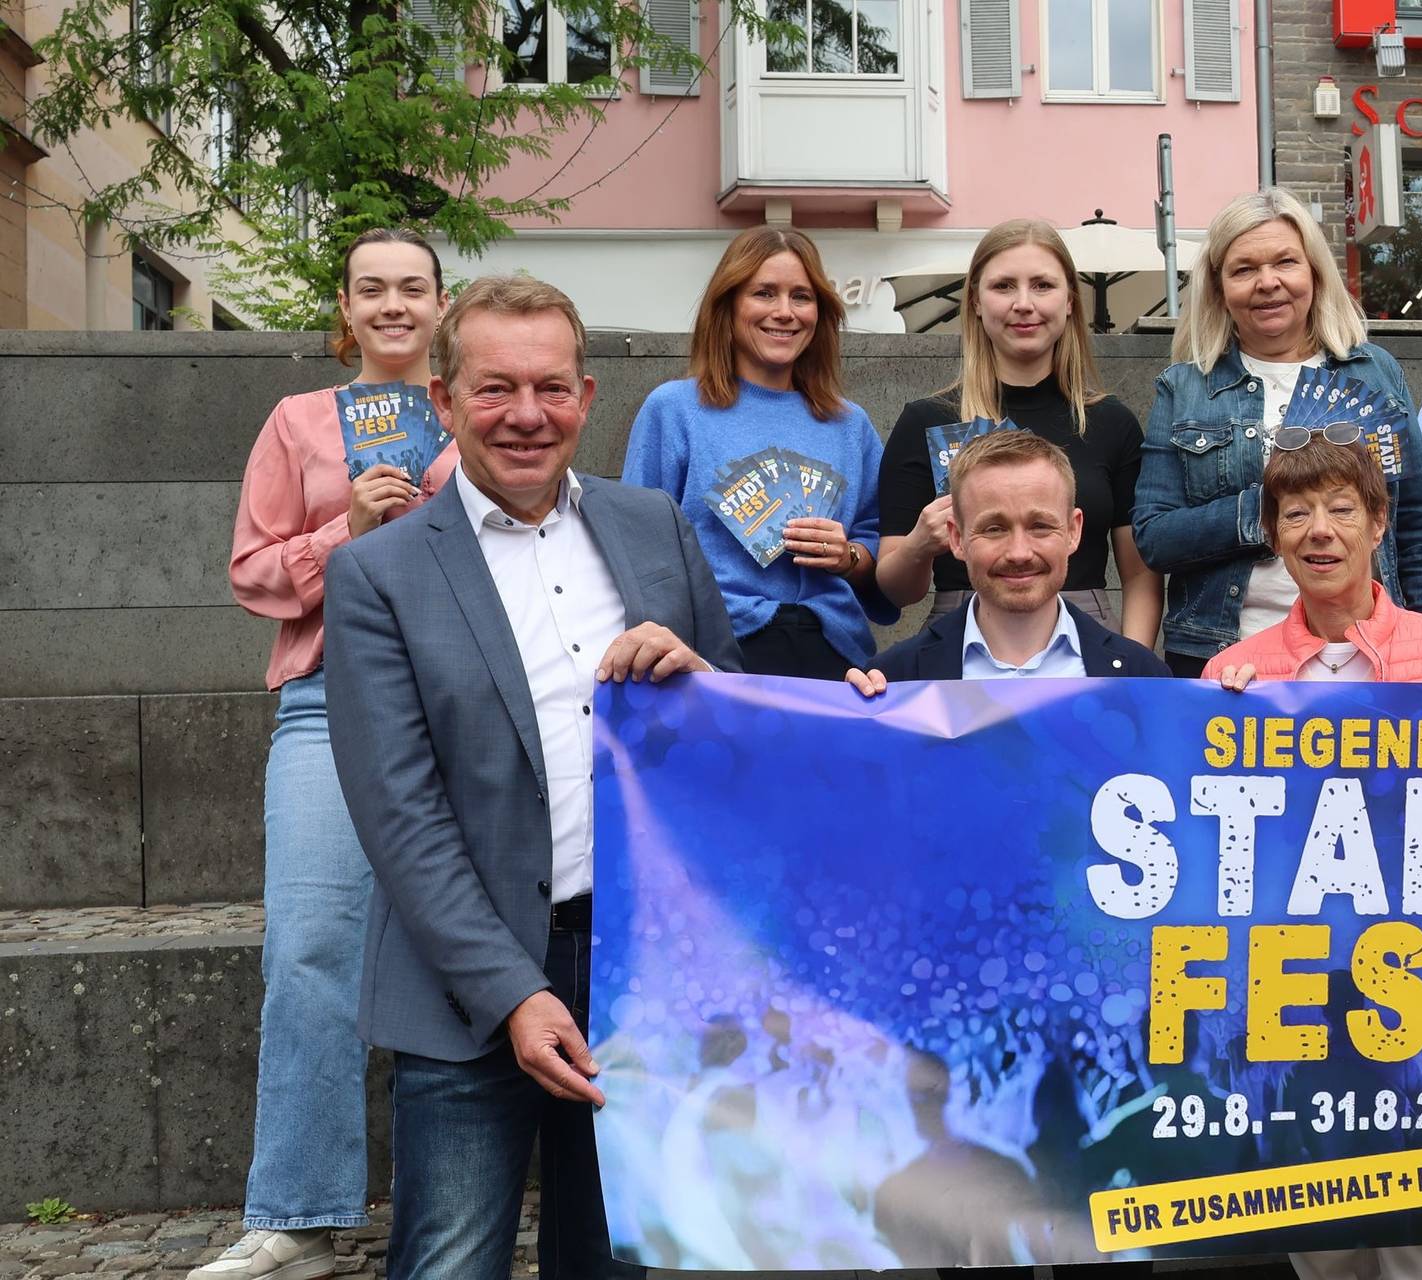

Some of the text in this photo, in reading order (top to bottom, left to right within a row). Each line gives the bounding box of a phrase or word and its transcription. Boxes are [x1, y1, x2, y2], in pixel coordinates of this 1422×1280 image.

[345, 398, 402, 422] STADT
[354, 414, 398, 437] FEST
[1376, 424, 1397, 475] STADT
[719, 473, 765, 517] STADT
[733, 489, 771, 524] FEST
[1107, 1196, 1163, 1237] FÜR
